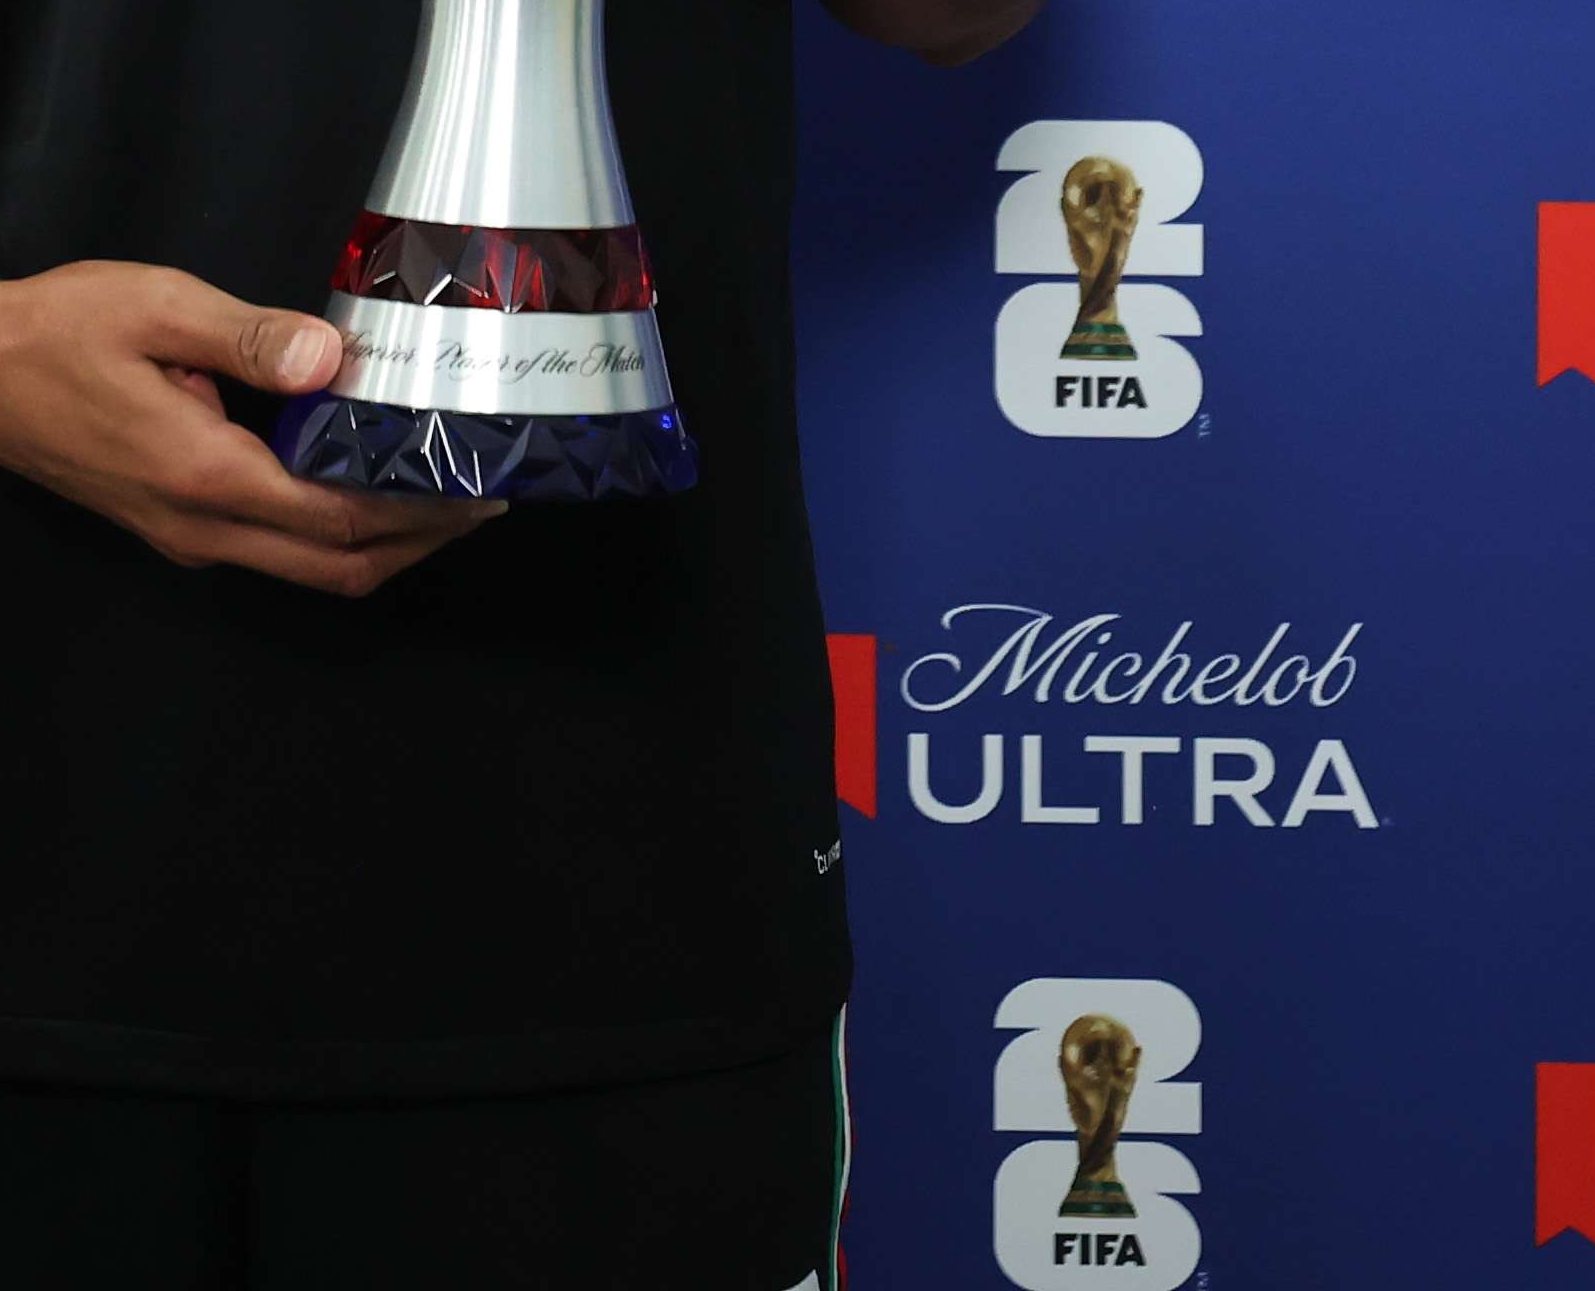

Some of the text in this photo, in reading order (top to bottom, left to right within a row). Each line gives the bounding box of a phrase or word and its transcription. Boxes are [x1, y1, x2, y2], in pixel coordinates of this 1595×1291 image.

[1055, 375, 1147, 409] FIFA
[901, 603, 1363, 711] Michelob
[908, 733, 1379, 828] ULTRA
[1054, 1232, 1146, 1267] FIFA
